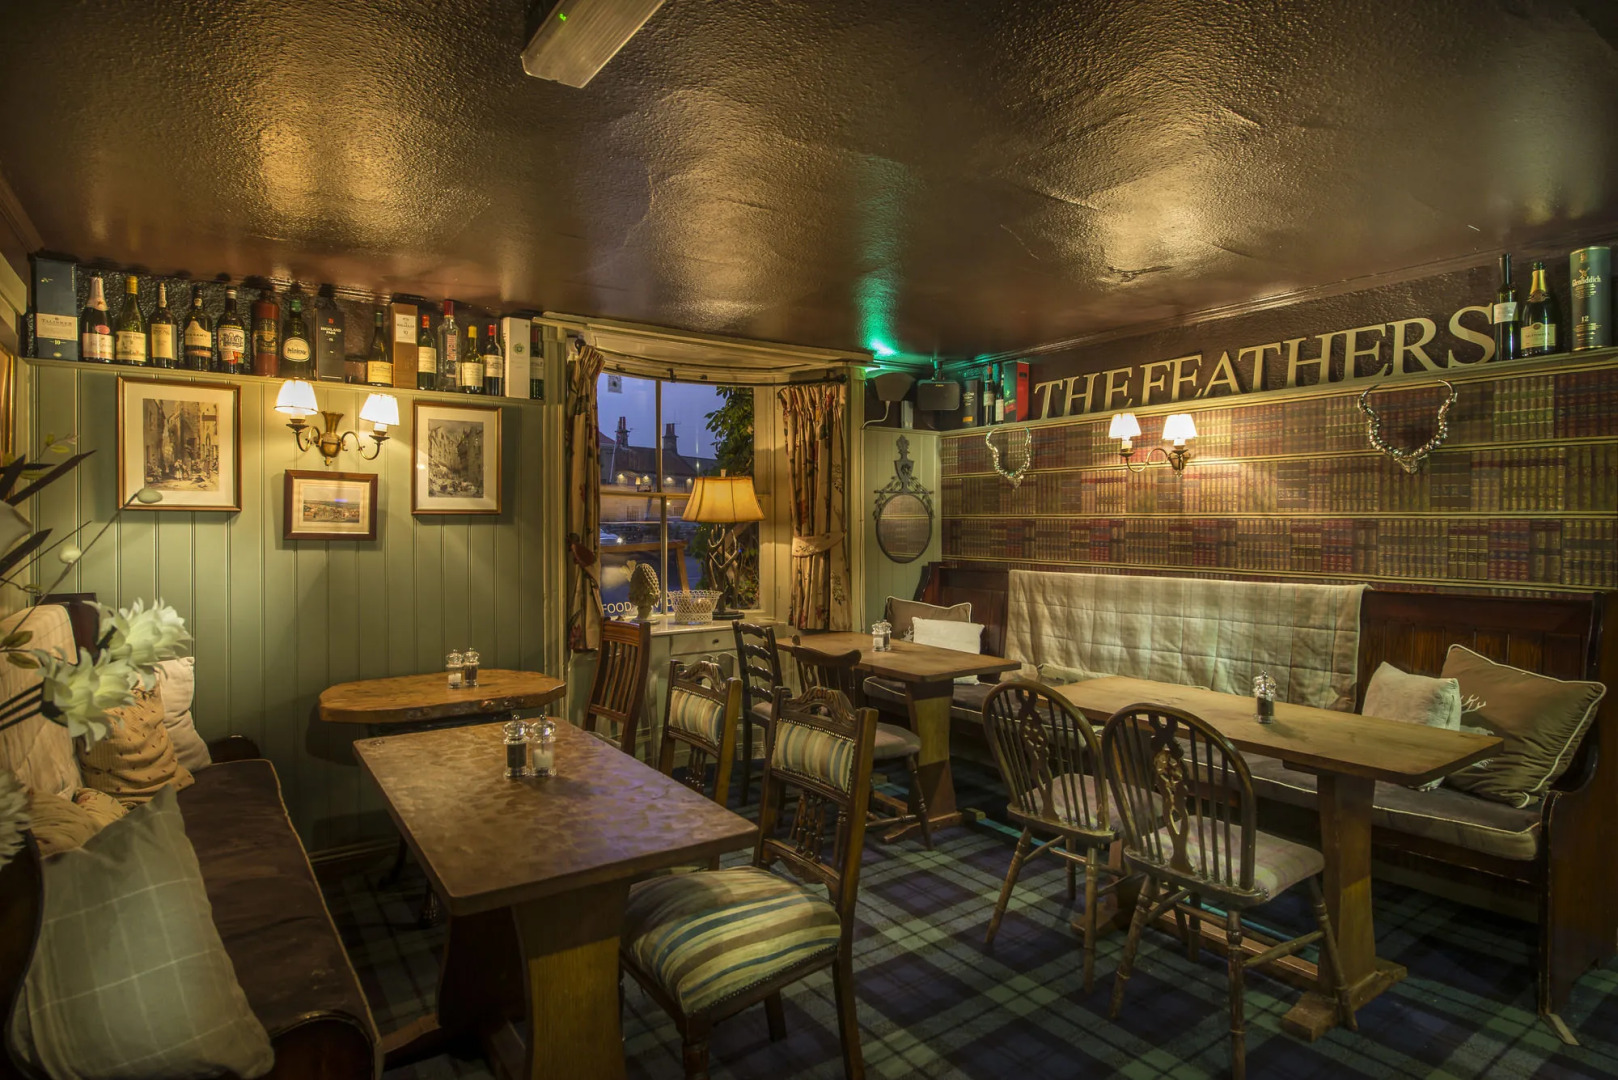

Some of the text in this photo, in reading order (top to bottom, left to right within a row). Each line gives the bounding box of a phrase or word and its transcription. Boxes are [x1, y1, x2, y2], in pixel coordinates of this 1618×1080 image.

[1034, 302, 1496, 420] THE FEATHERS
[602, 601, 632, 614] FOOD
